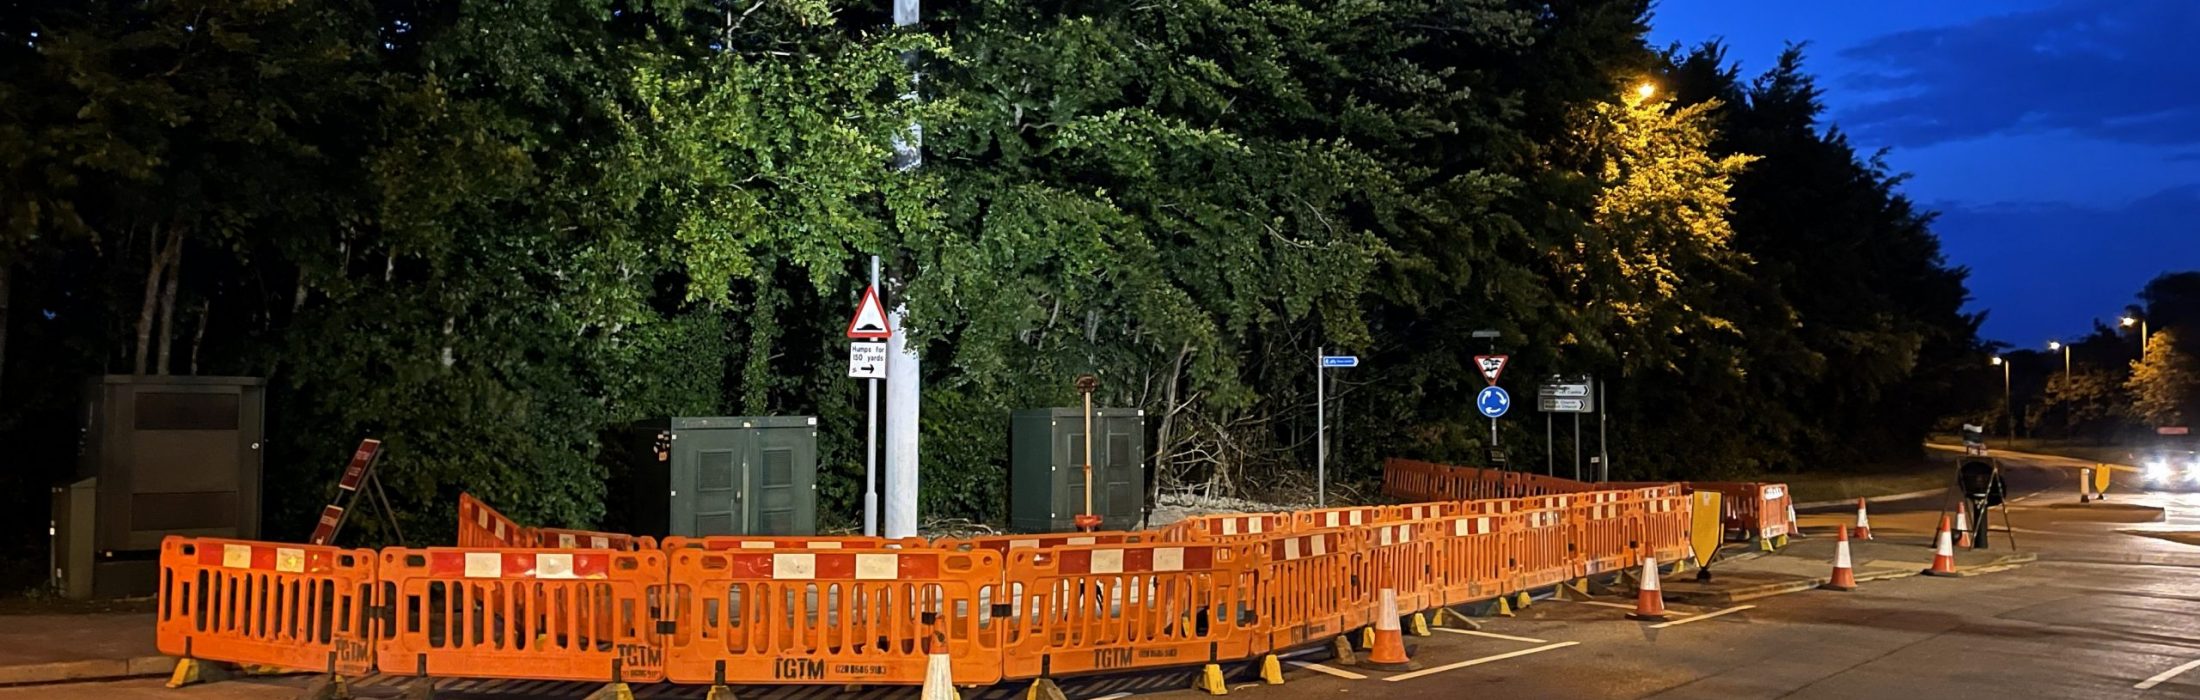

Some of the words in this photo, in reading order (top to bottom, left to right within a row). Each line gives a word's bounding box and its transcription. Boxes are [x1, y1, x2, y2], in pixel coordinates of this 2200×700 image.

[617, 644, 662, 667] TGTM
[1094, 646, 1134, 669] TGTM
[775, 658, 824, 679] TGTM
